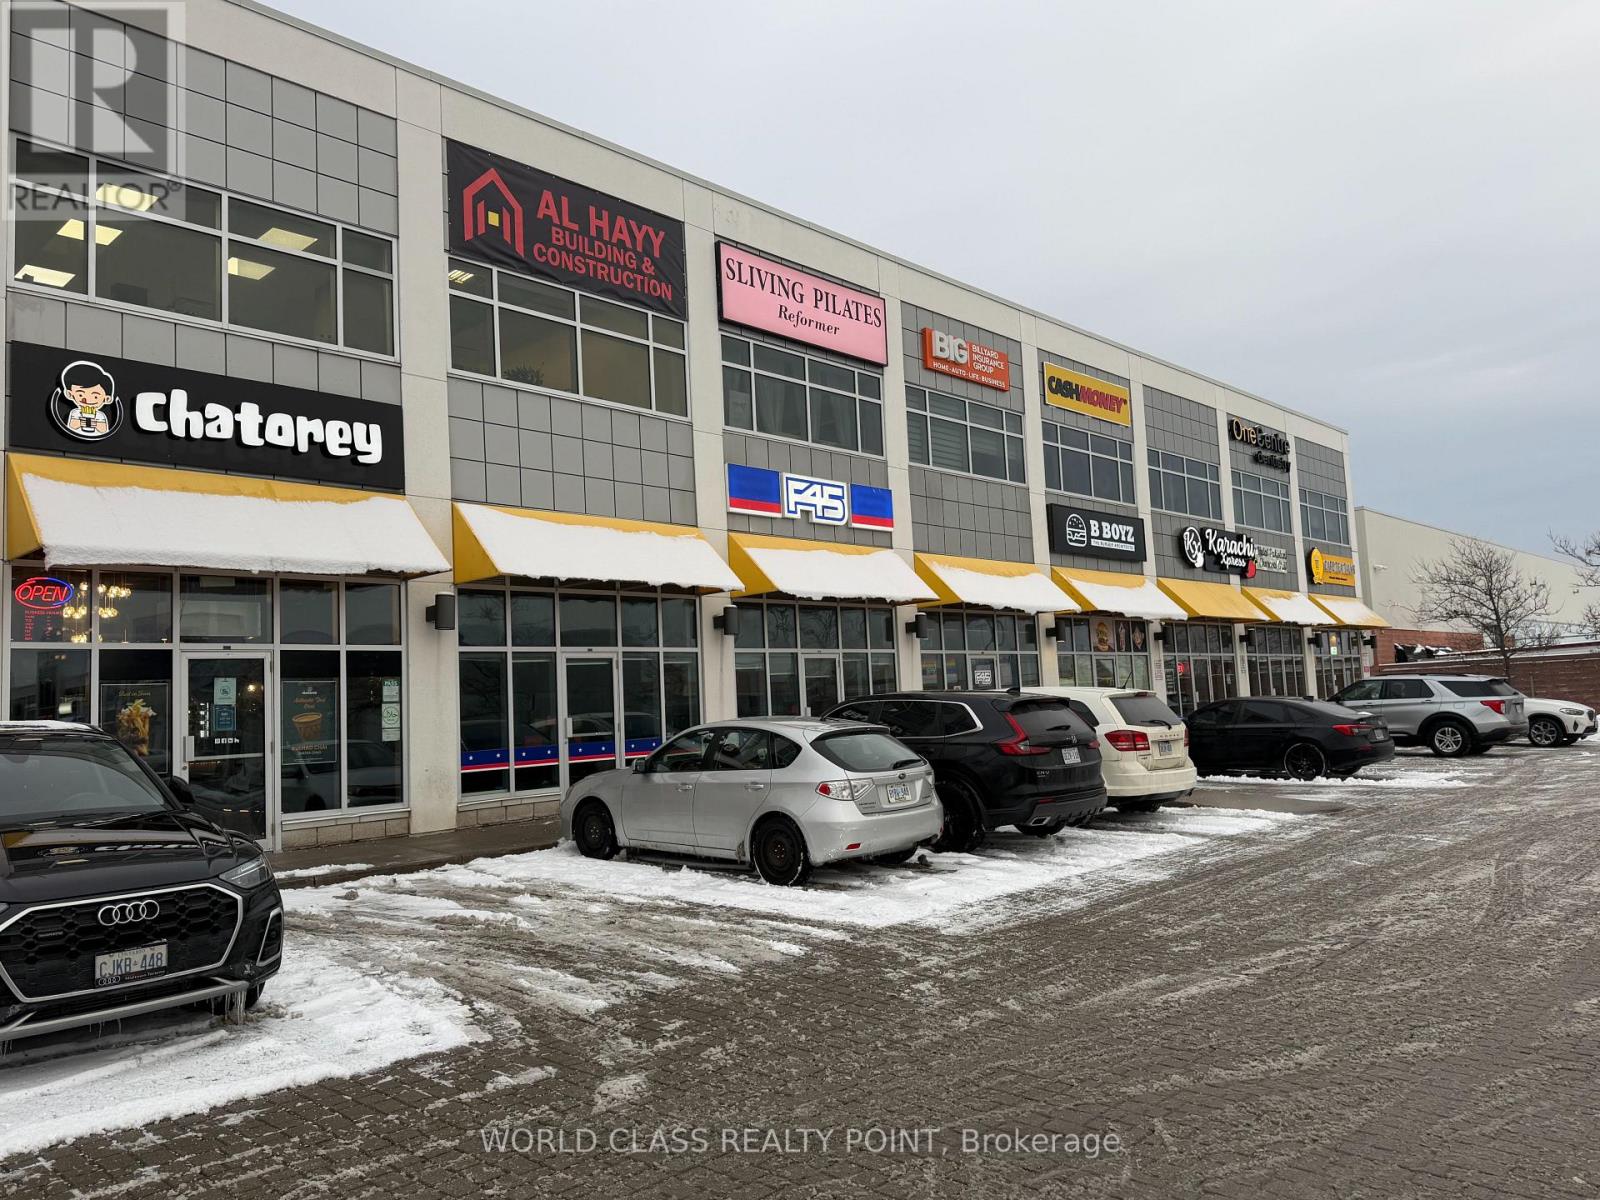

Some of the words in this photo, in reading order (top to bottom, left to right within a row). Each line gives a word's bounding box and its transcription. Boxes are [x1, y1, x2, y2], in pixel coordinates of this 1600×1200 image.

[536, 189, 579, 231] AL
[588, 205, 665, 258] HAYY
[551, 226, 637, 270] BUILDING
[641, 256, 656, 275] &
[532, 242, 673, 301] CONSTRUCTION
[725, 257, 805, 304] SLIVING
[812, 287, 882, 328] PILATES
[778, 304, 840, 335] Reformer
[932, 330, 969, 364] BIG
[971, 344, 999, 360] BILLYARD
[972, 353, 1005, 370] INSURANCE
[973, 362, 994, 375] GROUP
[135, 388, 383, 465] chatorey
[784, 473, 848, 526] F45
[1090, 519, 1100, 537] B
[1101, 521, 1135, 543] BOYZ
[1205, 528, 1255, 557] Karachi
[1220, 552, 1246, 570] Xpress
[19, 585, 68, 602] OPEN
[140, 951, 163, 969] 448
